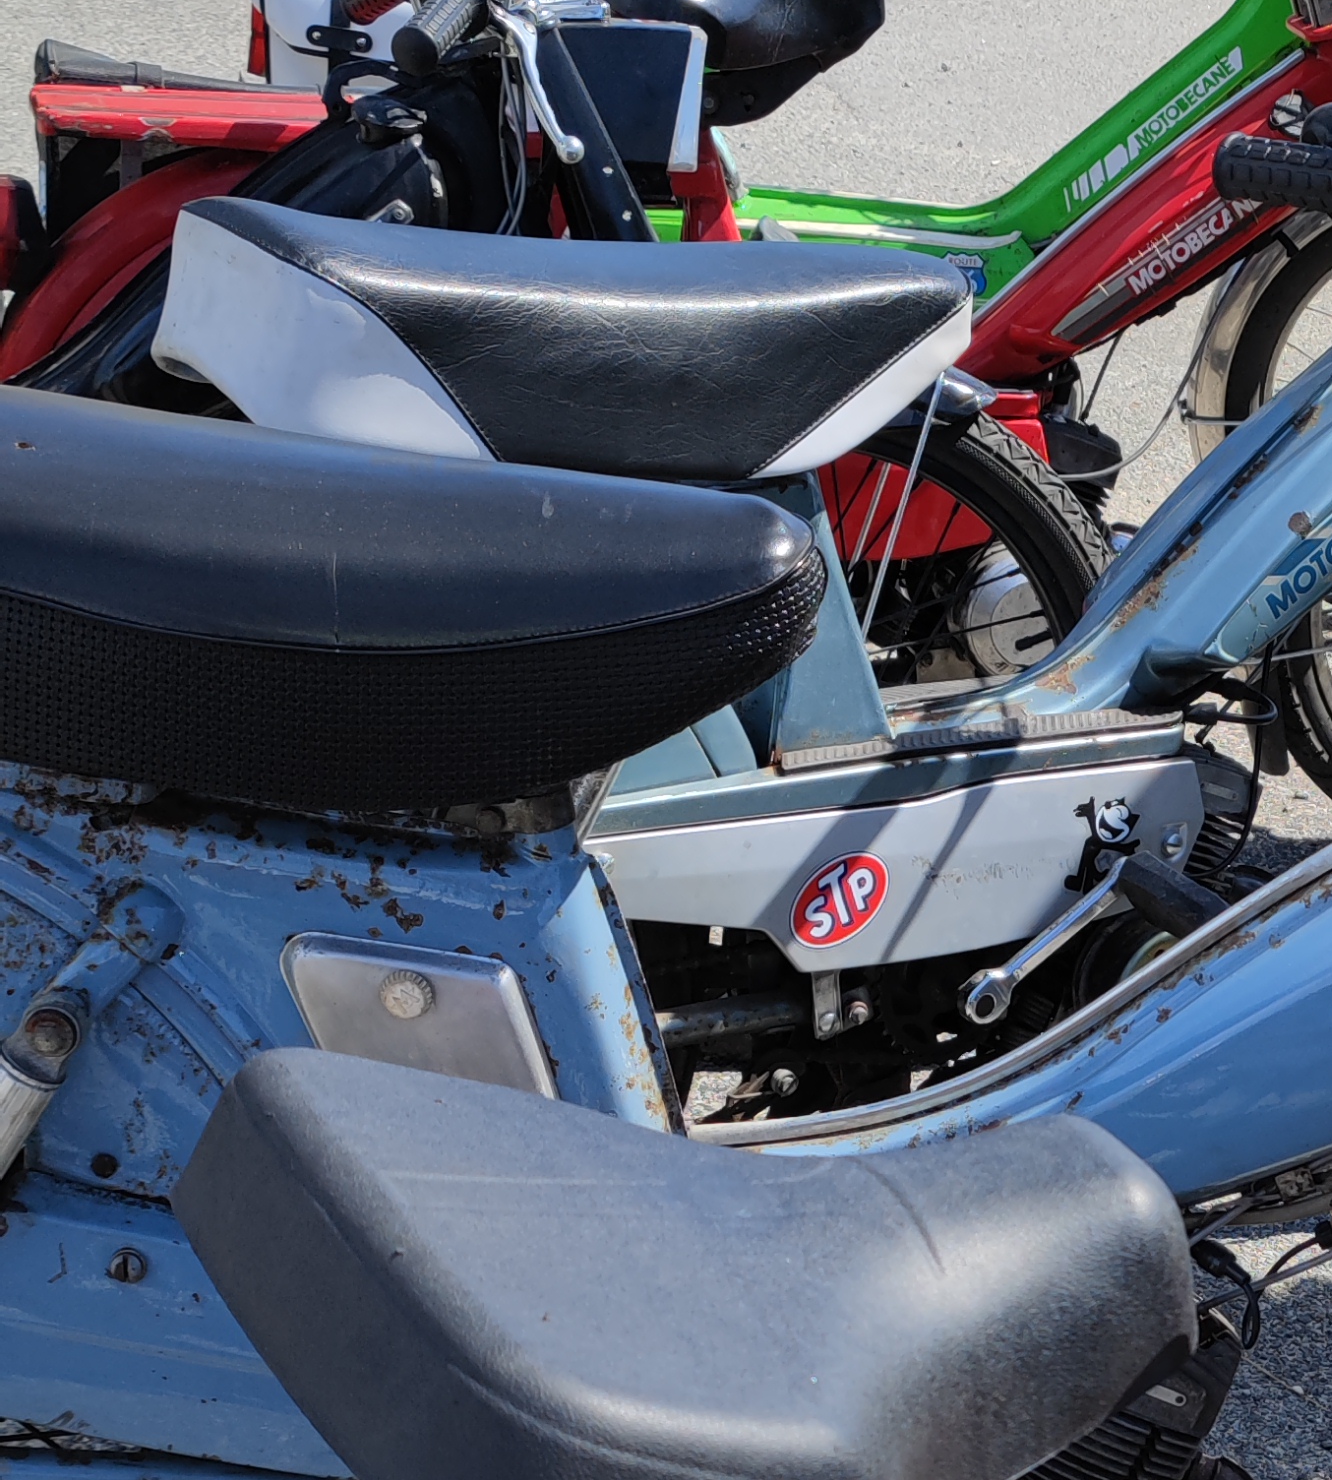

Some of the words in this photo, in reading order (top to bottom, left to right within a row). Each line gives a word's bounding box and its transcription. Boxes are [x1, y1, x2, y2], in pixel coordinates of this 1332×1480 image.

[1133, 56, 1236, 148] MOTOBECANE
[1127, 197, 1264, 295] MOTOBECAN
[804, 860, 877, 939] STP
